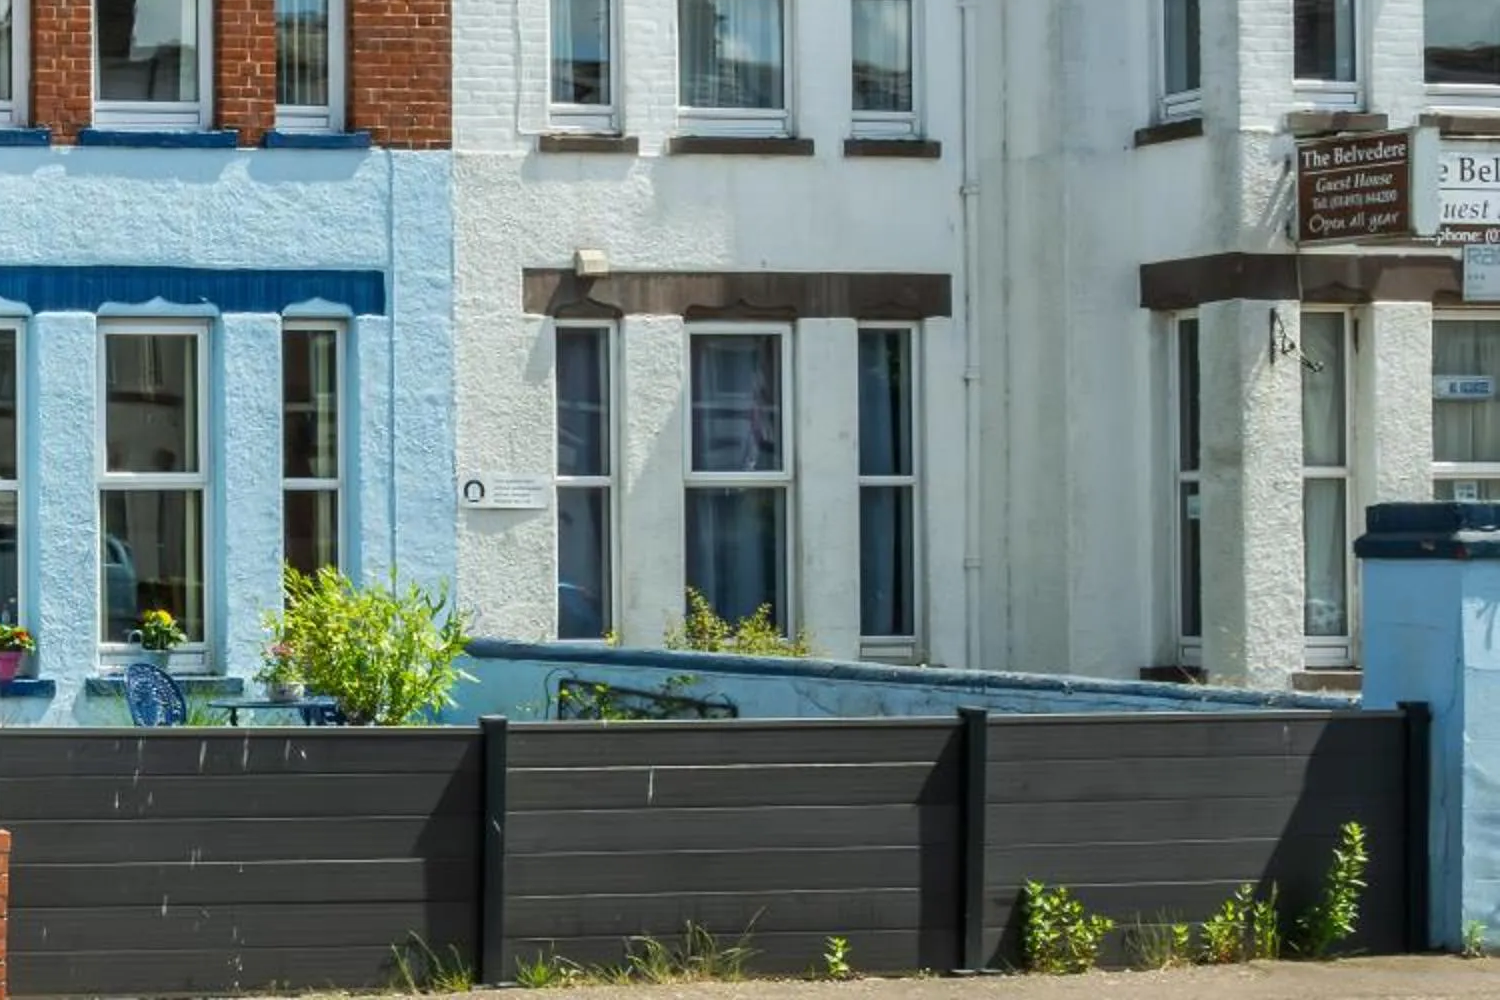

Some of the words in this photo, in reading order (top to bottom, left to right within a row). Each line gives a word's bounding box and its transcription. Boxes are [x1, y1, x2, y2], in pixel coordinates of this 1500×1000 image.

[1302, 151, 1331, 168] The
[1334, 141, 1406, 164] Belvedere
[1316, 175, 1351, 193] Guest
[1354, 173, 1393, 189] House
[1443, 200, 1489, 219] uest
[1309, 213, 1346, 236] Open
[1349, 211, 1365, 227] all
[1367, 211, 1400, 233] year
